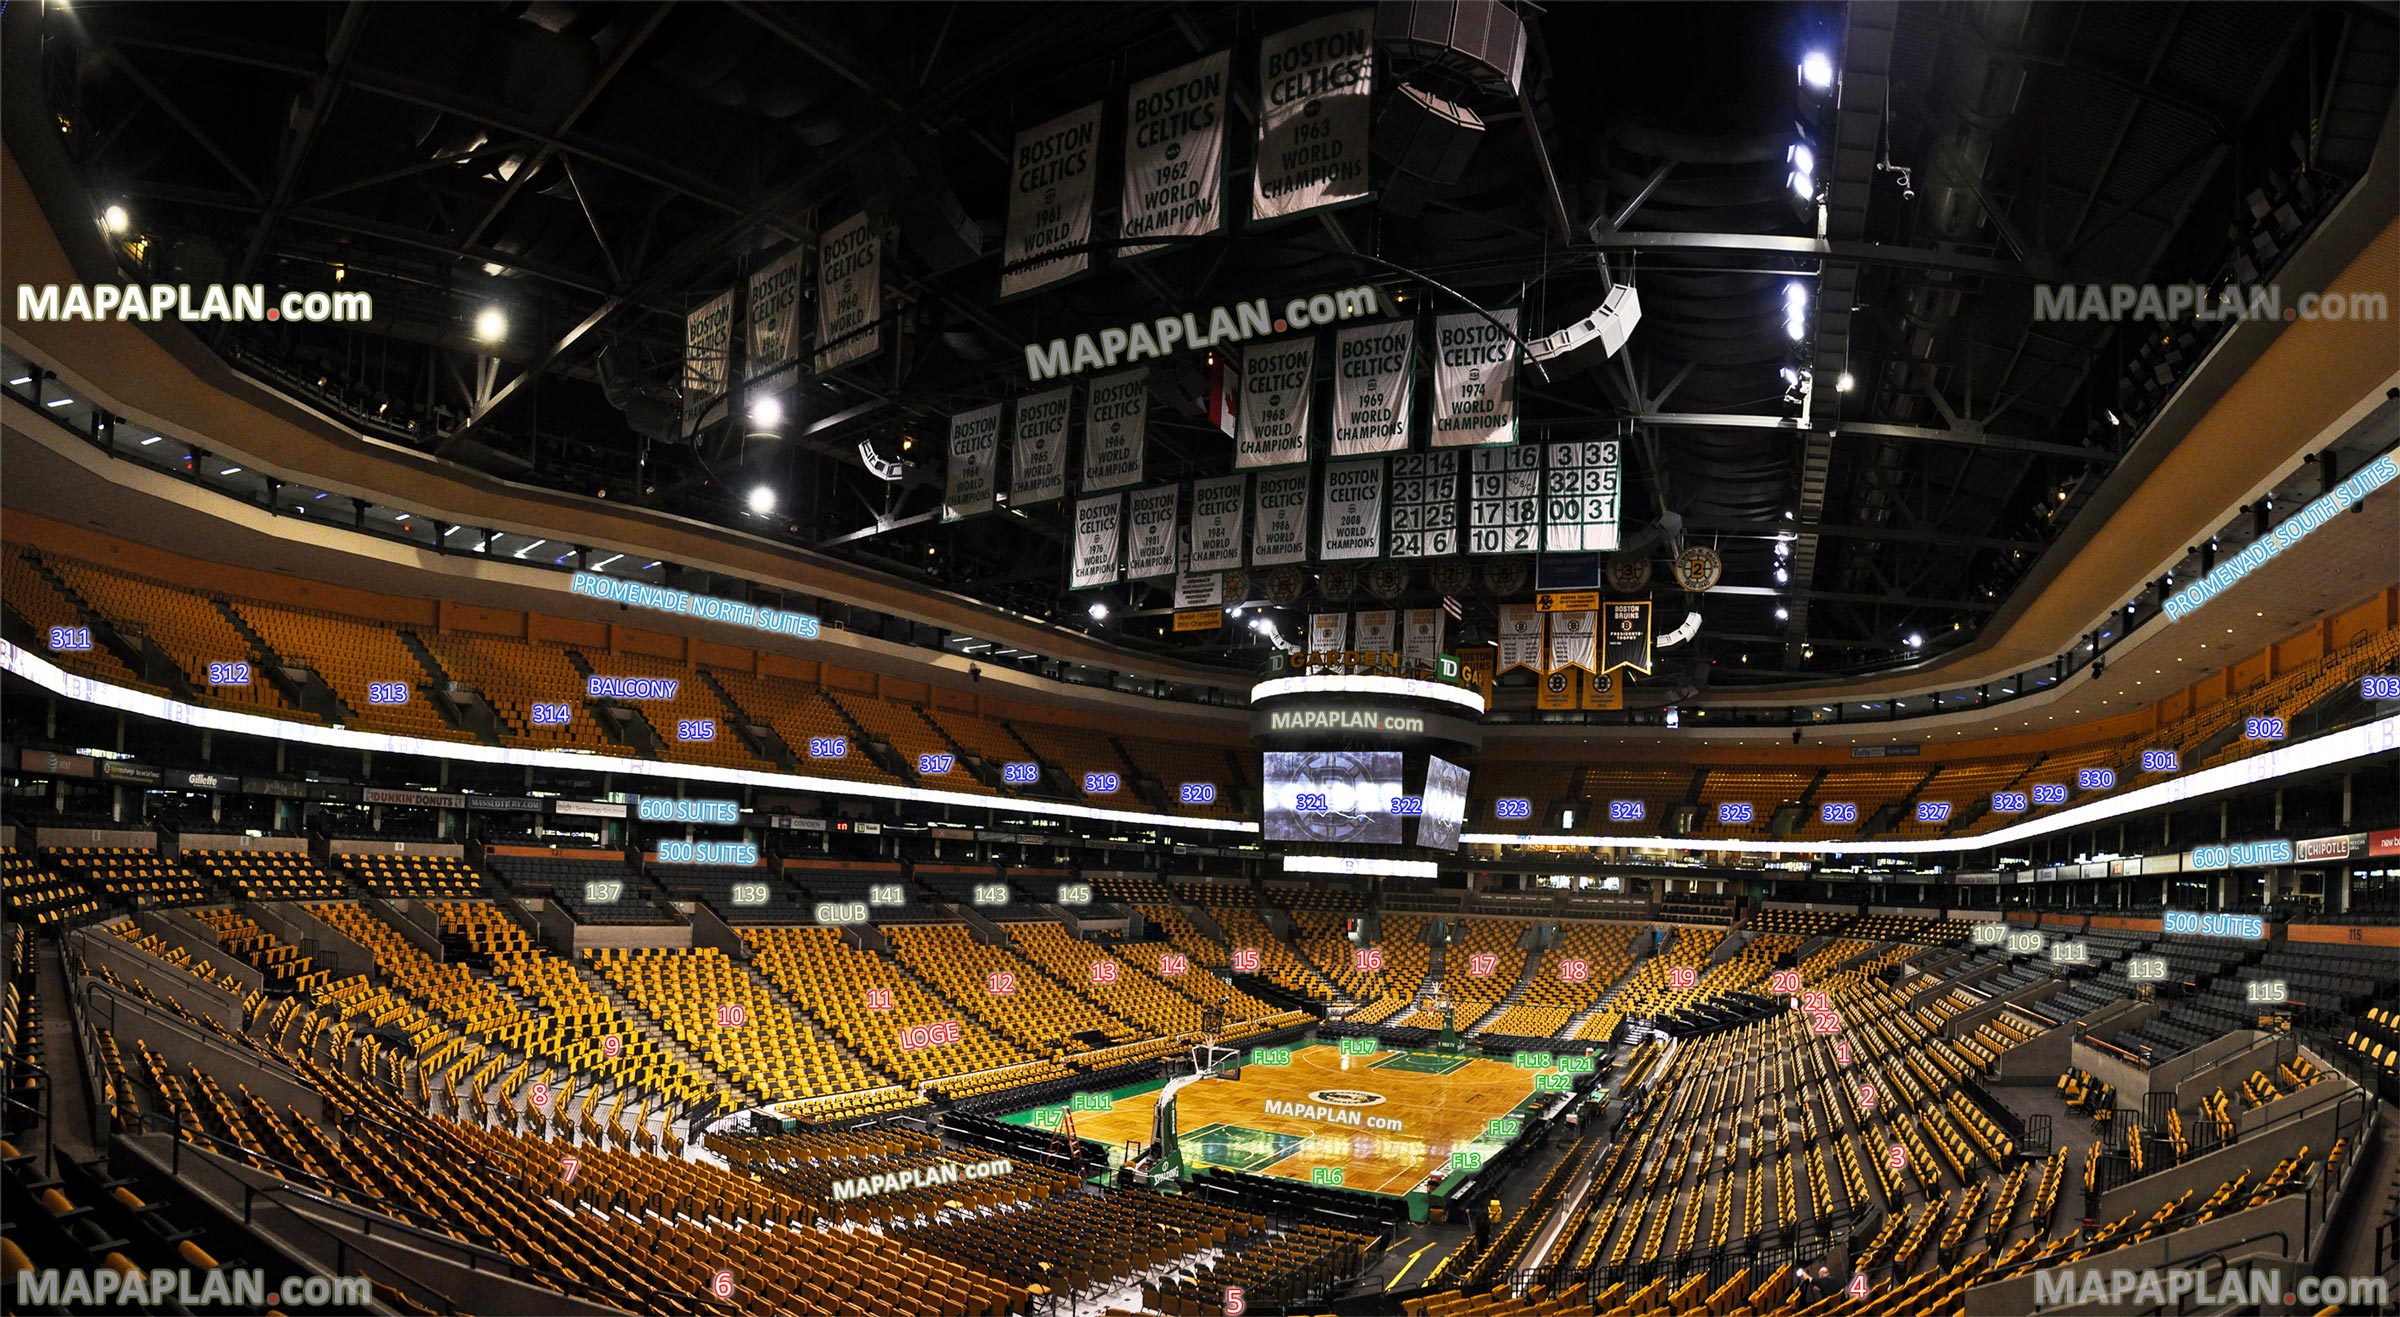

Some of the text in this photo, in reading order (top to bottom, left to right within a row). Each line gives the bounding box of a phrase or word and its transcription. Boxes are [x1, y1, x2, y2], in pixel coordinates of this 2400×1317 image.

[1269, 29, 1364, 80] BOSTON
[1270, 60, 1359, 106] CELTICS
[1135, 73, 1220, 123] BOSTON
[1136, 102, 1215, 148] CELTICS
[1293, 120, 1330, 145] 1963
[1282, 140, 1343, 171] WORLD
[1157, 161, 1187, 184] 1962
[1262, 159, 1362, 199] CHAMPIONS
[1145, 180, 1199, 211] WORLD
[1126, 198, 1212, 236] CHAMPIONS
[1442, 323, 1511, 347] BOSTON
[1342, 333, 1406, 359] BOSTON
[1444, 344, 1507, 367] CELTICS
[1343, 355, 1402, 379] CELTICS
[1359, 394, 1384, 407] 1969
[1461, 384, 1486, 398] 1974
[1351, 409, 1391, 424] WORLD
[1451, 399, 1494, 414] WORLD
[1337, 422, 1403, 441] CHAMPIONS
[1437, 414, 1507, 431] CHAMPIONS
[1426, 453, 1455, 474] 14
[1481, 450, 1492, 470] 1
[1510, 446, 1537, 468] 16
[1557, 446, 1572, 466] 3
[1586, 443, 1618, 465] 33
[1329, 468, 1378, 486] BOSTON
[1394, 456, 1423, 477] 22
[1426, 478, 1453, 499] 15
[1475, 475, 1501, 496] 19
[1550, 472, 1580, 493] 32
[1586, 470, 1618, 490] 35
[1330, 484, 1376, 502] CELTICS
[1393, 481, 1422, 501] 23
[1394, 508, 1421, 529] 21
[1425, 505, 1455, 526] 25
[1474, 503, 1500, 524] 17
[1509, 500, 1535, 522] 18
[1550, 500, 1580, 521] 00
[1588, 498, 1616, 519] 31
[1341, 515, 1361, 525] 2008
[1336, 525, 1366, 537] WORLD
[1473, 529, 1500, 551] 10
[1515, 527, 1529, 549] 2
[1326, 537, 1374, 550] CHAMPIONS
[1392, 533, 1421, 555] 24
[1433, 532, 1447, 553] 6
[1693, 563, 1702, 575] 2
[1290, 650, 1399, 668] GARDEN
[188, 773, 218, 786] Gillette
[373, 790, 453, 807] DUNKIN' DONUTS
[2307, 841, 2347, 856] CHIPOTLE
[2349, 929, 2362, 940] 115
[1154, 1166, 1179, 1186] SPALDING
